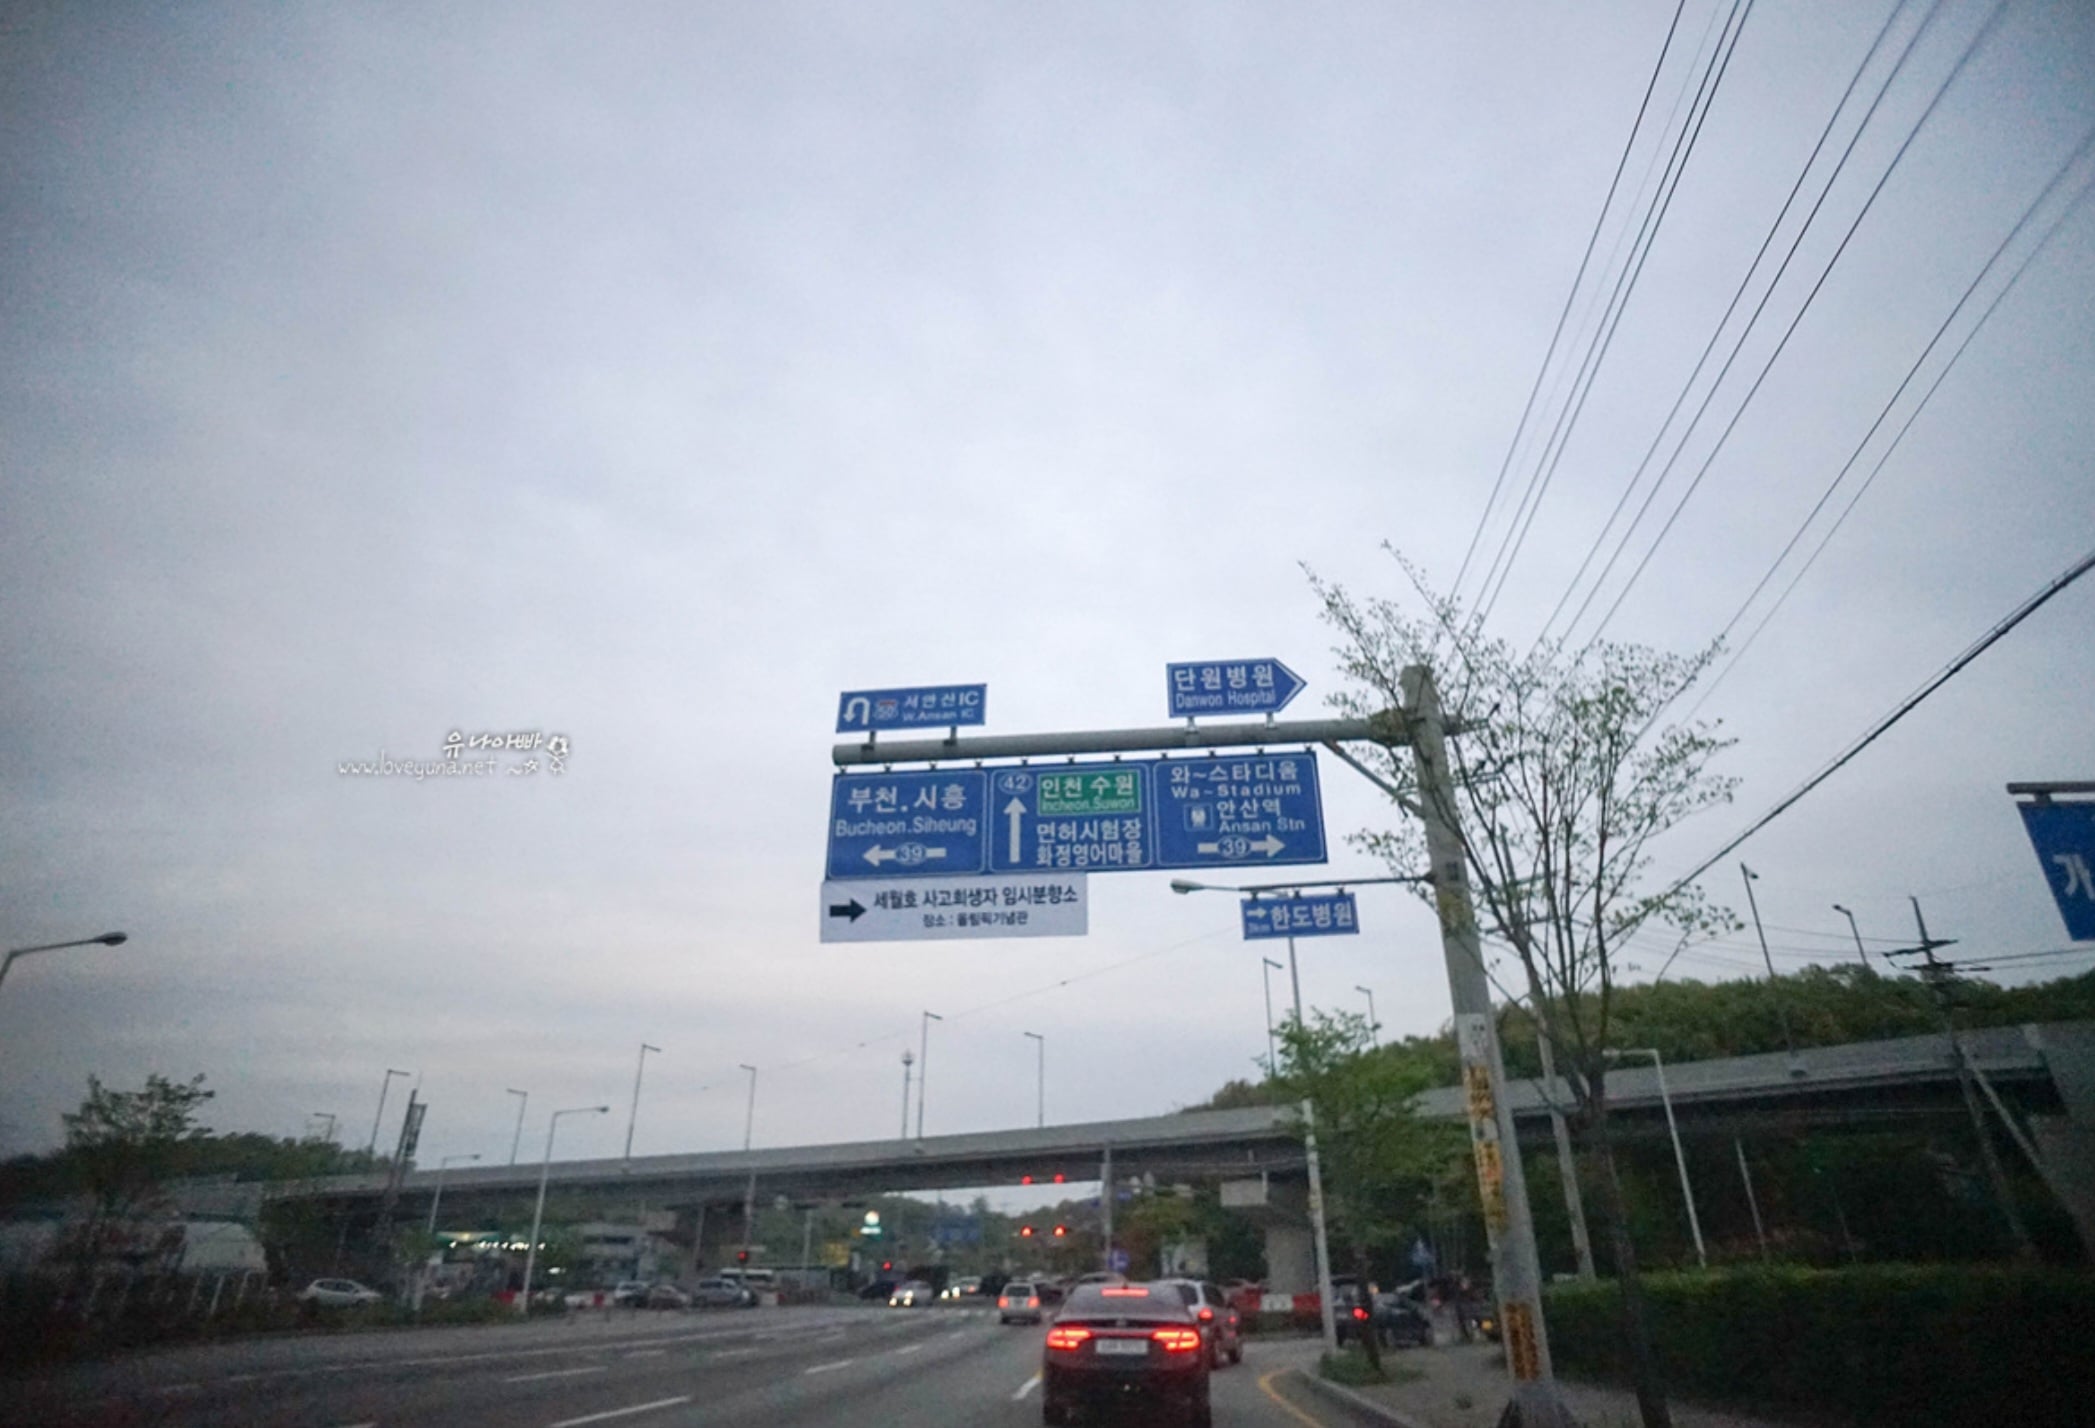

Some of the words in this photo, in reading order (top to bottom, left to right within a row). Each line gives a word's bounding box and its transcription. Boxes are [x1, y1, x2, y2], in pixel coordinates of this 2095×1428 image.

[1174, 664, 1274, 691] 단원병원
[1176, 694, 1223, 709] Danwon
[1227, 690, 1276, 707] Hospital
[1003, 775, 1027, 790] 42
[1216, 799, 1282, 820] 안산역
[1036, 817, 1142, 844] 면허시험장
[1218, 820, 1271, 834] Ansan
[900, 844, 922, 862] 39
[1036, 841, 1143, 867] 화정영어마을
[1223, 838, 1248, 857] 39
[873, 889, 918, 910] 세월호
[1002, 884, 1078, 905] 임시분향소
[1271, 902, 1353, 931] 한도병원
